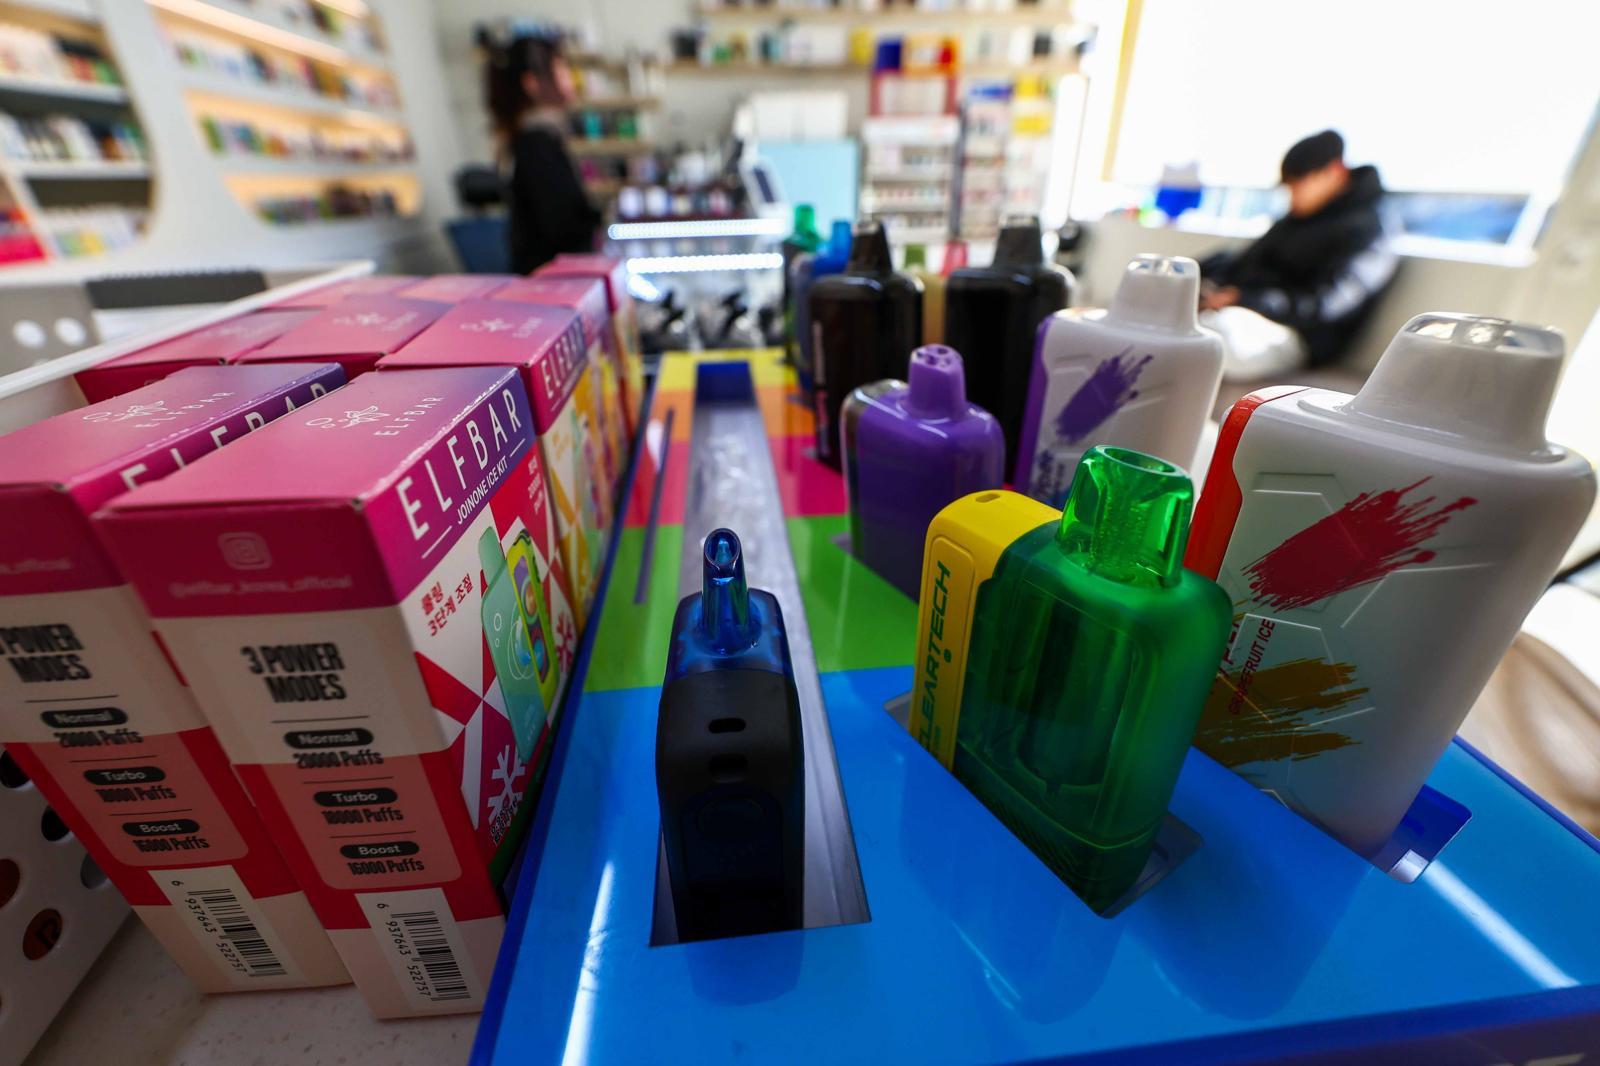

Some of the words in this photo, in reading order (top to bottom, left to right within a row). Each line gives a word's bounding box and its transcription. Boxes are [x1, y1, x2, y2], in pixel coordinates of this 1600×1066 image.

[373, 397, 444, 436] ELFBAR
[395, 388, 522, 541] ELFBAR
[457, 478, 489, 525] JOINONE
[487, 466, 500, 488] ICE
[497, 454, 509, 476] KIT
[428, 595, 456, 636] 3단계
[455, 573, 473, 604] 조절
[0, 623, 84, 654] POWER
[1256, 619, 1275, 642] ICE
[8, 654, 93, 683] MODES
[242, 646, 263, 674] 3
[259, 642, 345, 673] POWER
[264, 674, 347, 703] MODES
[297, 730, 360, 745] Normal
[339, 749, 384, 767] Puffs
[101, 771, 147, 782] Turbo
[134, 785, 177, 802] Puffs
[332, 791, 378, 802] Turbo
[362, 806, 404, 822] Puffs
[139, 821, 182, 833] Boost
[168, 835, 211, 851] Puffs
[359, 844, 401, 855] Boost
[347, 860, 387, 876] 16000
[388, 858, 425, 873] Puffs
[184, 898, 217, 934] 937643
[216, 942, 248, 973] 522757
[386, 920, 412, 956] 937643
[406, 964, 432, 997] 522757
